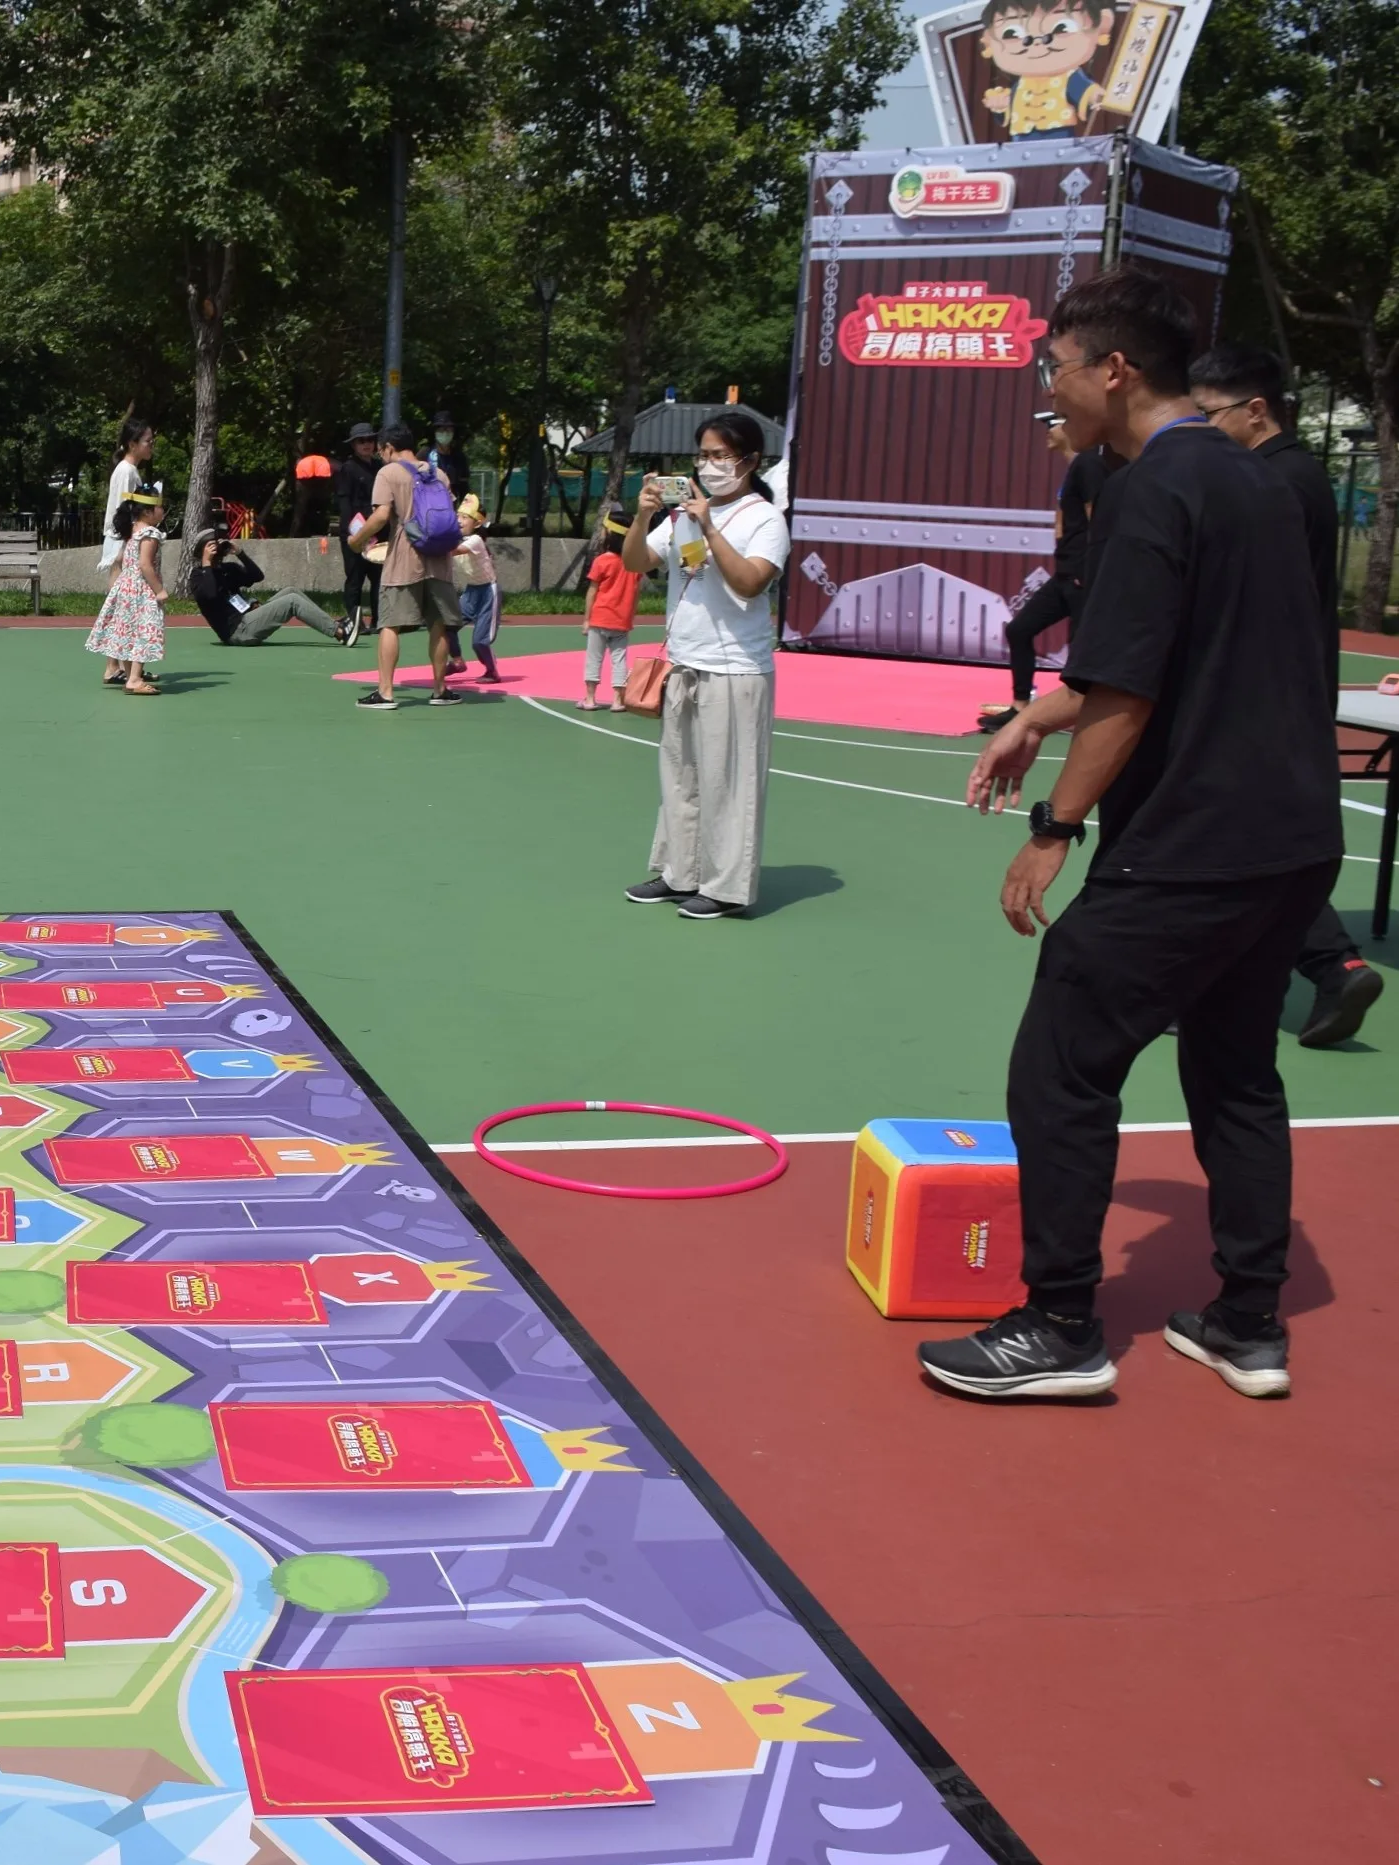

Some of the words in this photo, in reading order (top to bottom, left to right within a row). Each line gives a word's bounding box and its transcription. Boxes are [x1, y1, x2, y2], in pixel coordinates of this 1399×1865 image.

[878, 303, 1010, 328] HAKKA
[859, 332, 1019, 361] 冒險搞頭王
[176, 988, 204, 996] U
[219, 1059, 252, 1067] V
[276, 1149, 315, 1160] W
[351, 1270, 399, 1285] X
[190, 1278, 207, 1306] HAKKA
[22, 1362, 68, 1382] R
[357, 1425, 385, 1463] HAKKA
[69, 1578, 127, 1605] S
[625, 1701, 699, 1733] Z
[417, 1703, 459, 1766] HAKKA
